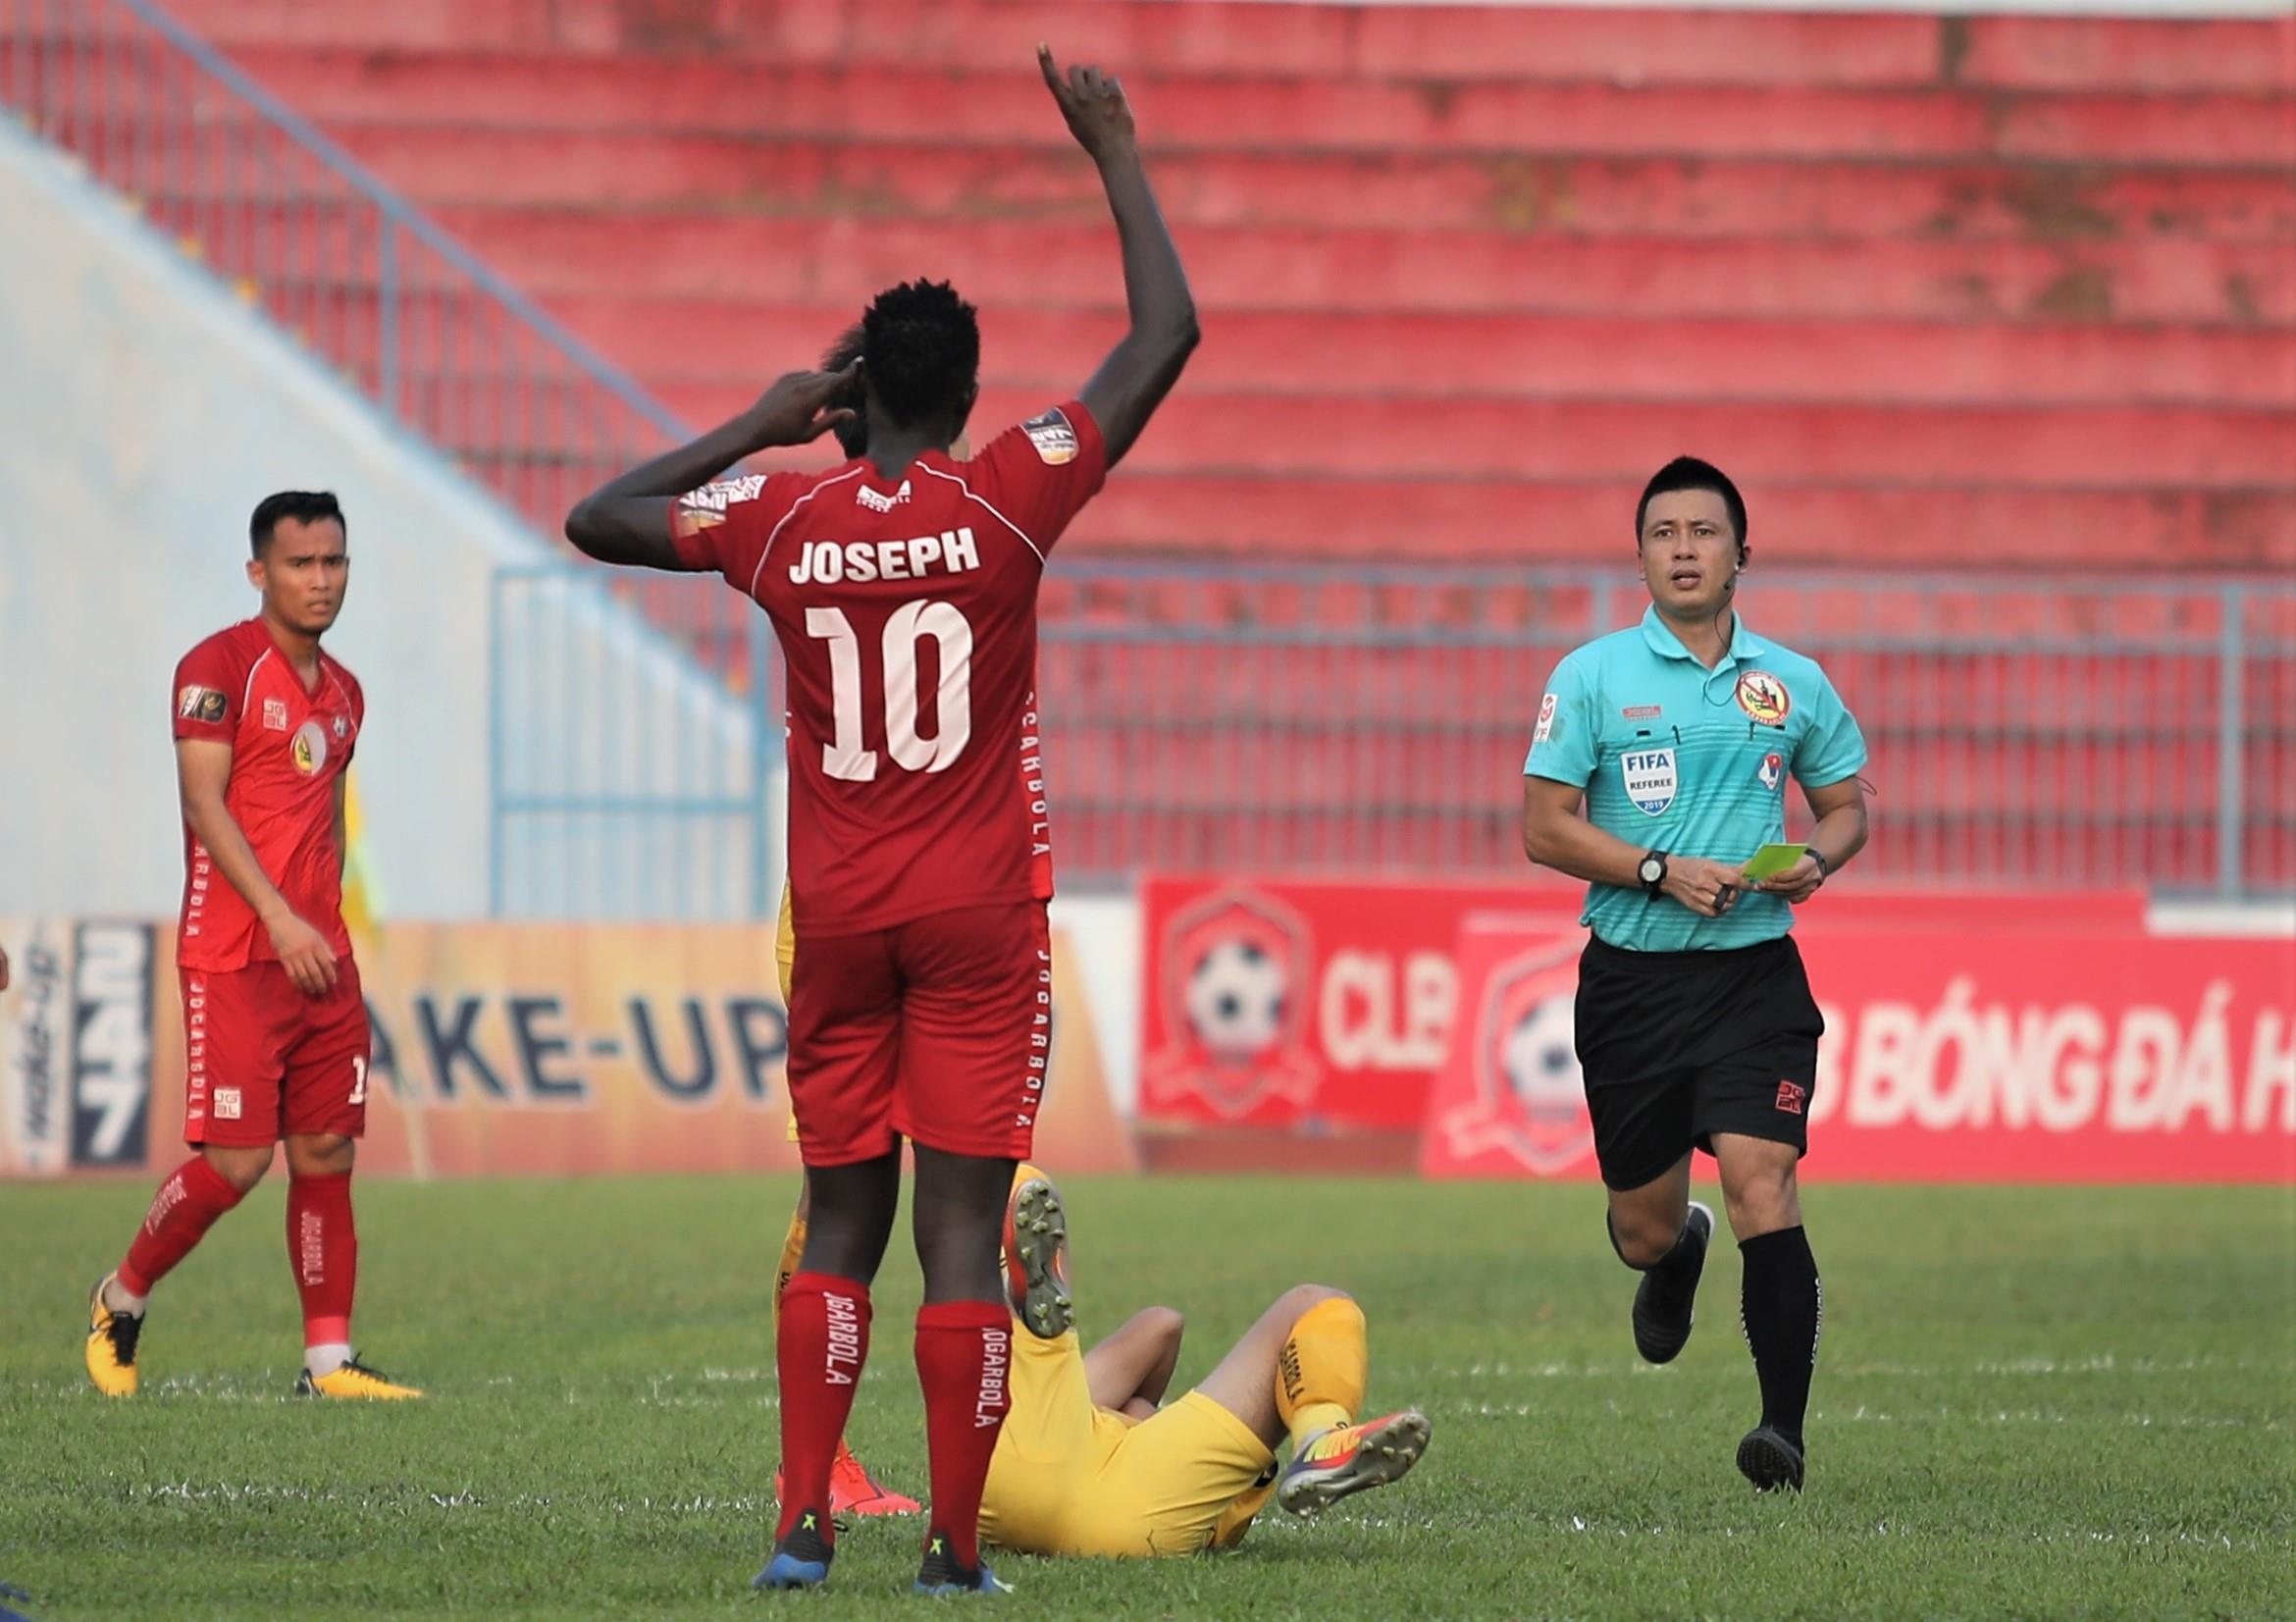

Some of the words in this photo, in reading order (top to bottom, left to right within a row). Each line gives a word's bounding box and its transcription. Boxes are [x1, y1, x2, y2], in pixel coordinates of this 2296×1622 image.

[789, 527, 980, 585] JOSEPH
[805, 599, 973, 782] 10
[1627, 753, 1669, 771] FIFA
[1630, 778, 1673, 791] REFEREE
[1644, 801, 1664, 811] 2019
[1846, 972, 2107, 1131] BÓNG
[2107, 978, 2236, 1133] ĐÁ
